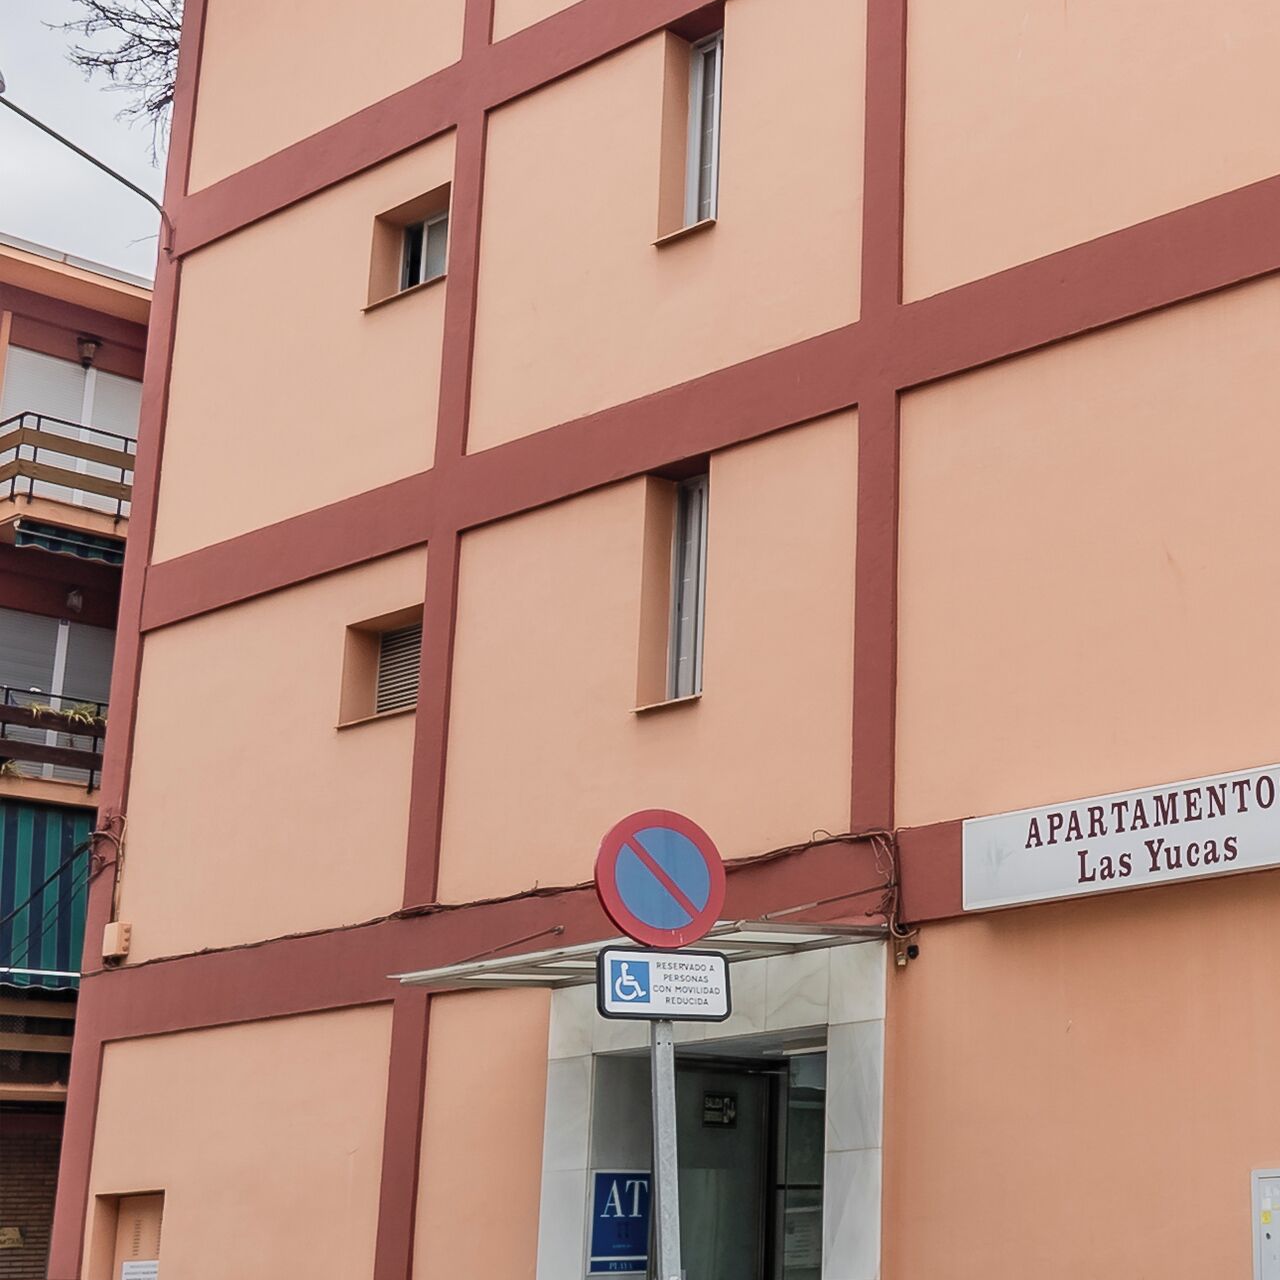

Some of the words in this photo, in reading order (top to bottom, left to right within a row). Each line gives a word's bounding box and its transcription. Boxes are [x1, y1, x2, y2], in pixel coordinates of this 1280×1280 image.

[1077, 849, 1132, 883] Las
[1144, 835, 1239, 872] Yucas
[656, 961, 707, 972] RESERVADO
[709, 964, 715, 972] A
[663, 973, 709, 983] PERSONAS
[652, 984, 672, 993] CON
[674, 985, 721, 995] MOVILIDAD
[665, 996, 709, 1006] REDUCIDA
[600, 1180, 648, 1217] AT
